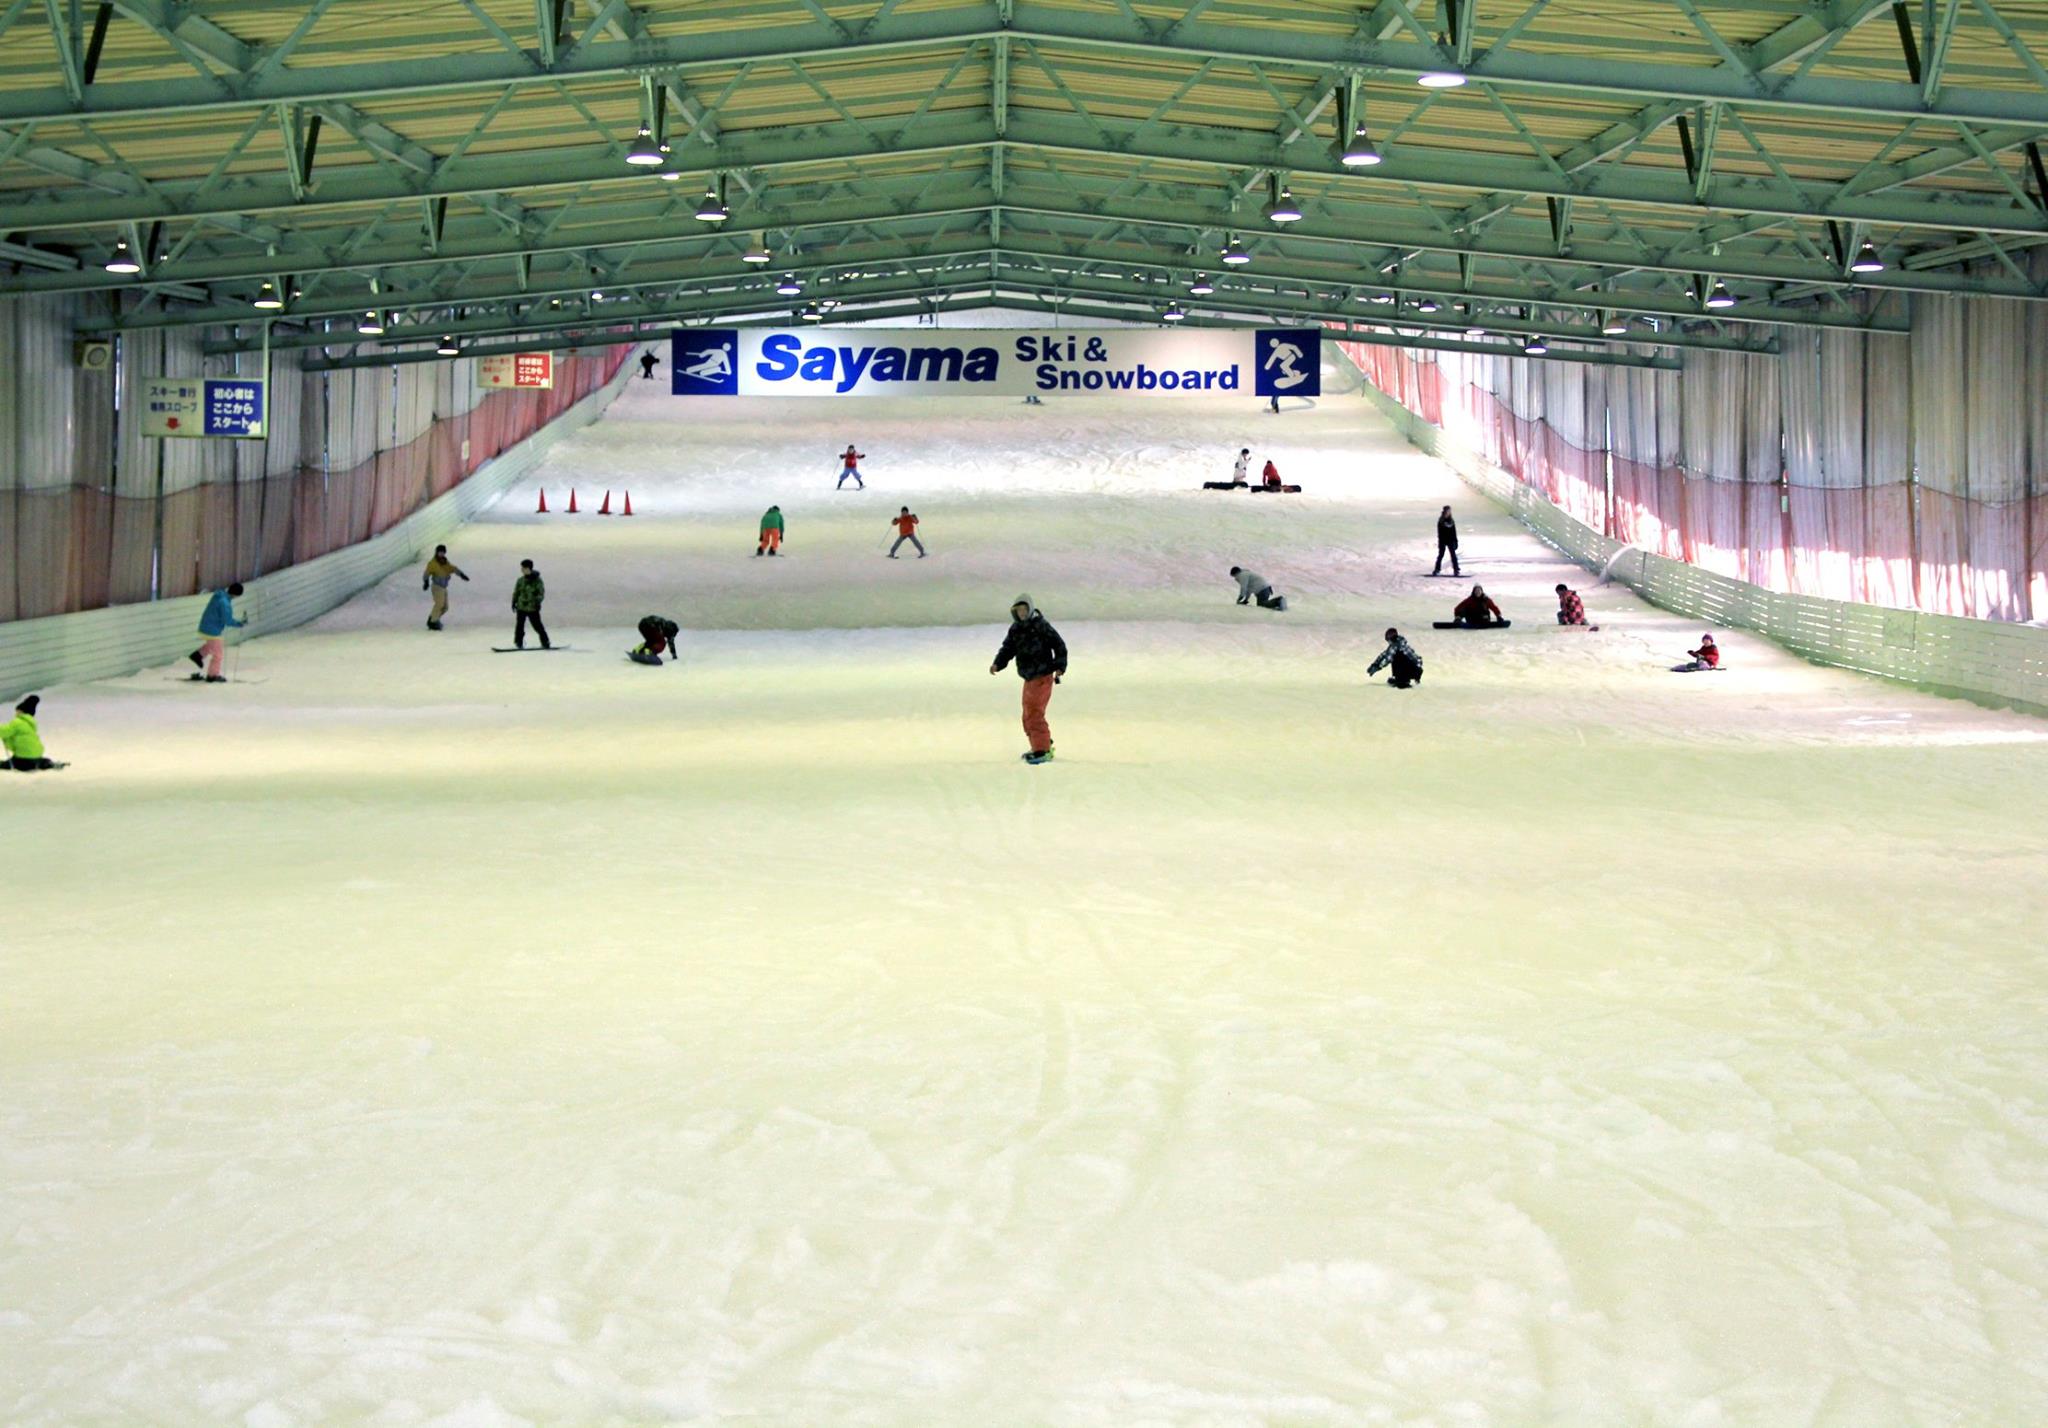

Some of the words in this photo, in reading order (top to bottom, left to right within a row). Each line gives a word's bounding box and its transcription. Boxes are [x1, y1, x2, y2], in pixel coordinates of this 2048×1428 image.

[1015, 335, 1076, 362] Ski
[1083, 337, 1107, 362] &
[756, 334, 999, 393] Sayama
[1035, 363, 1239, 390] Snowboard
[213, 402, 254, 415] ここから
[212, 416, 249, 429] スタート
